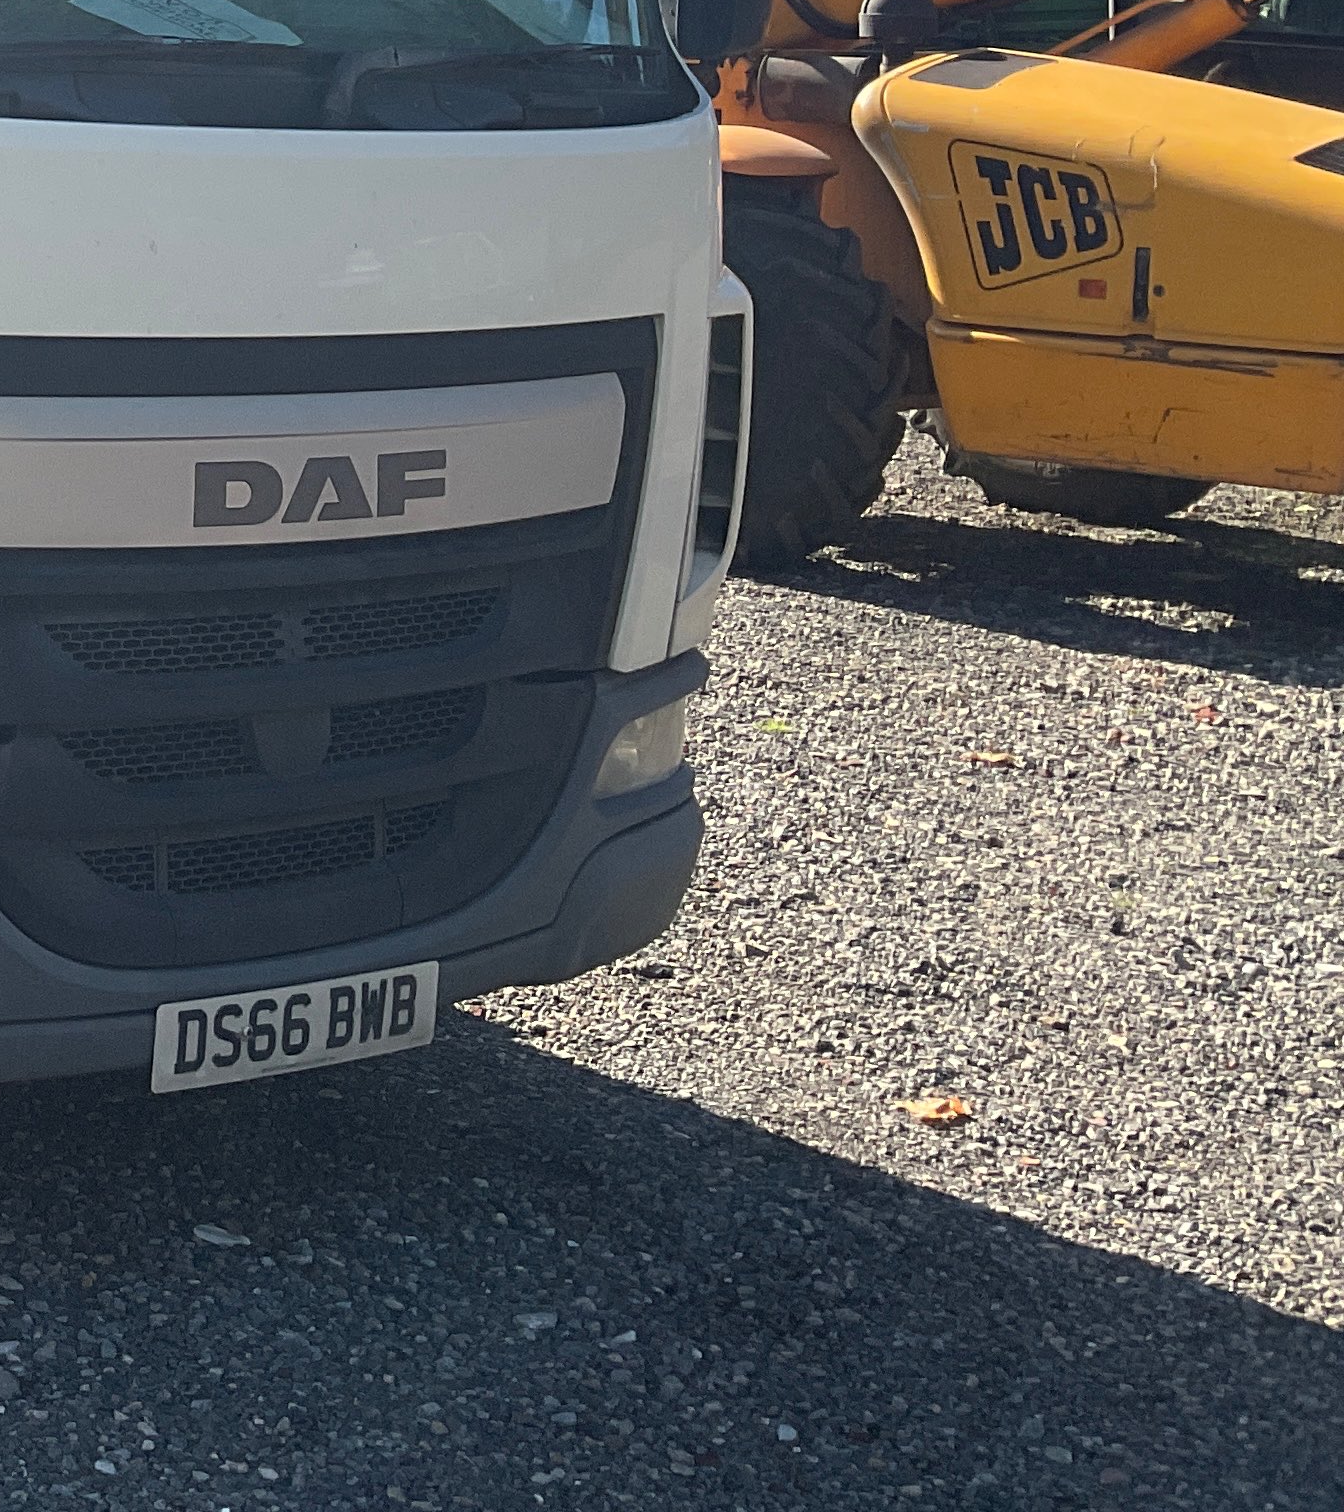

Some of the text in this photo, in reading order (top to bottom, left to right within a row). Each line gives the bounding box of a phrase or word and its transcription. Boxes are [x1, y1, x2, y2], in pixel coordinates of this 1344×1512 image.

[975, 155, 1109, 276] JCB
[192, 449, 447, 528] DAF
[173, 974, 418, 1075] DS66 BWB
